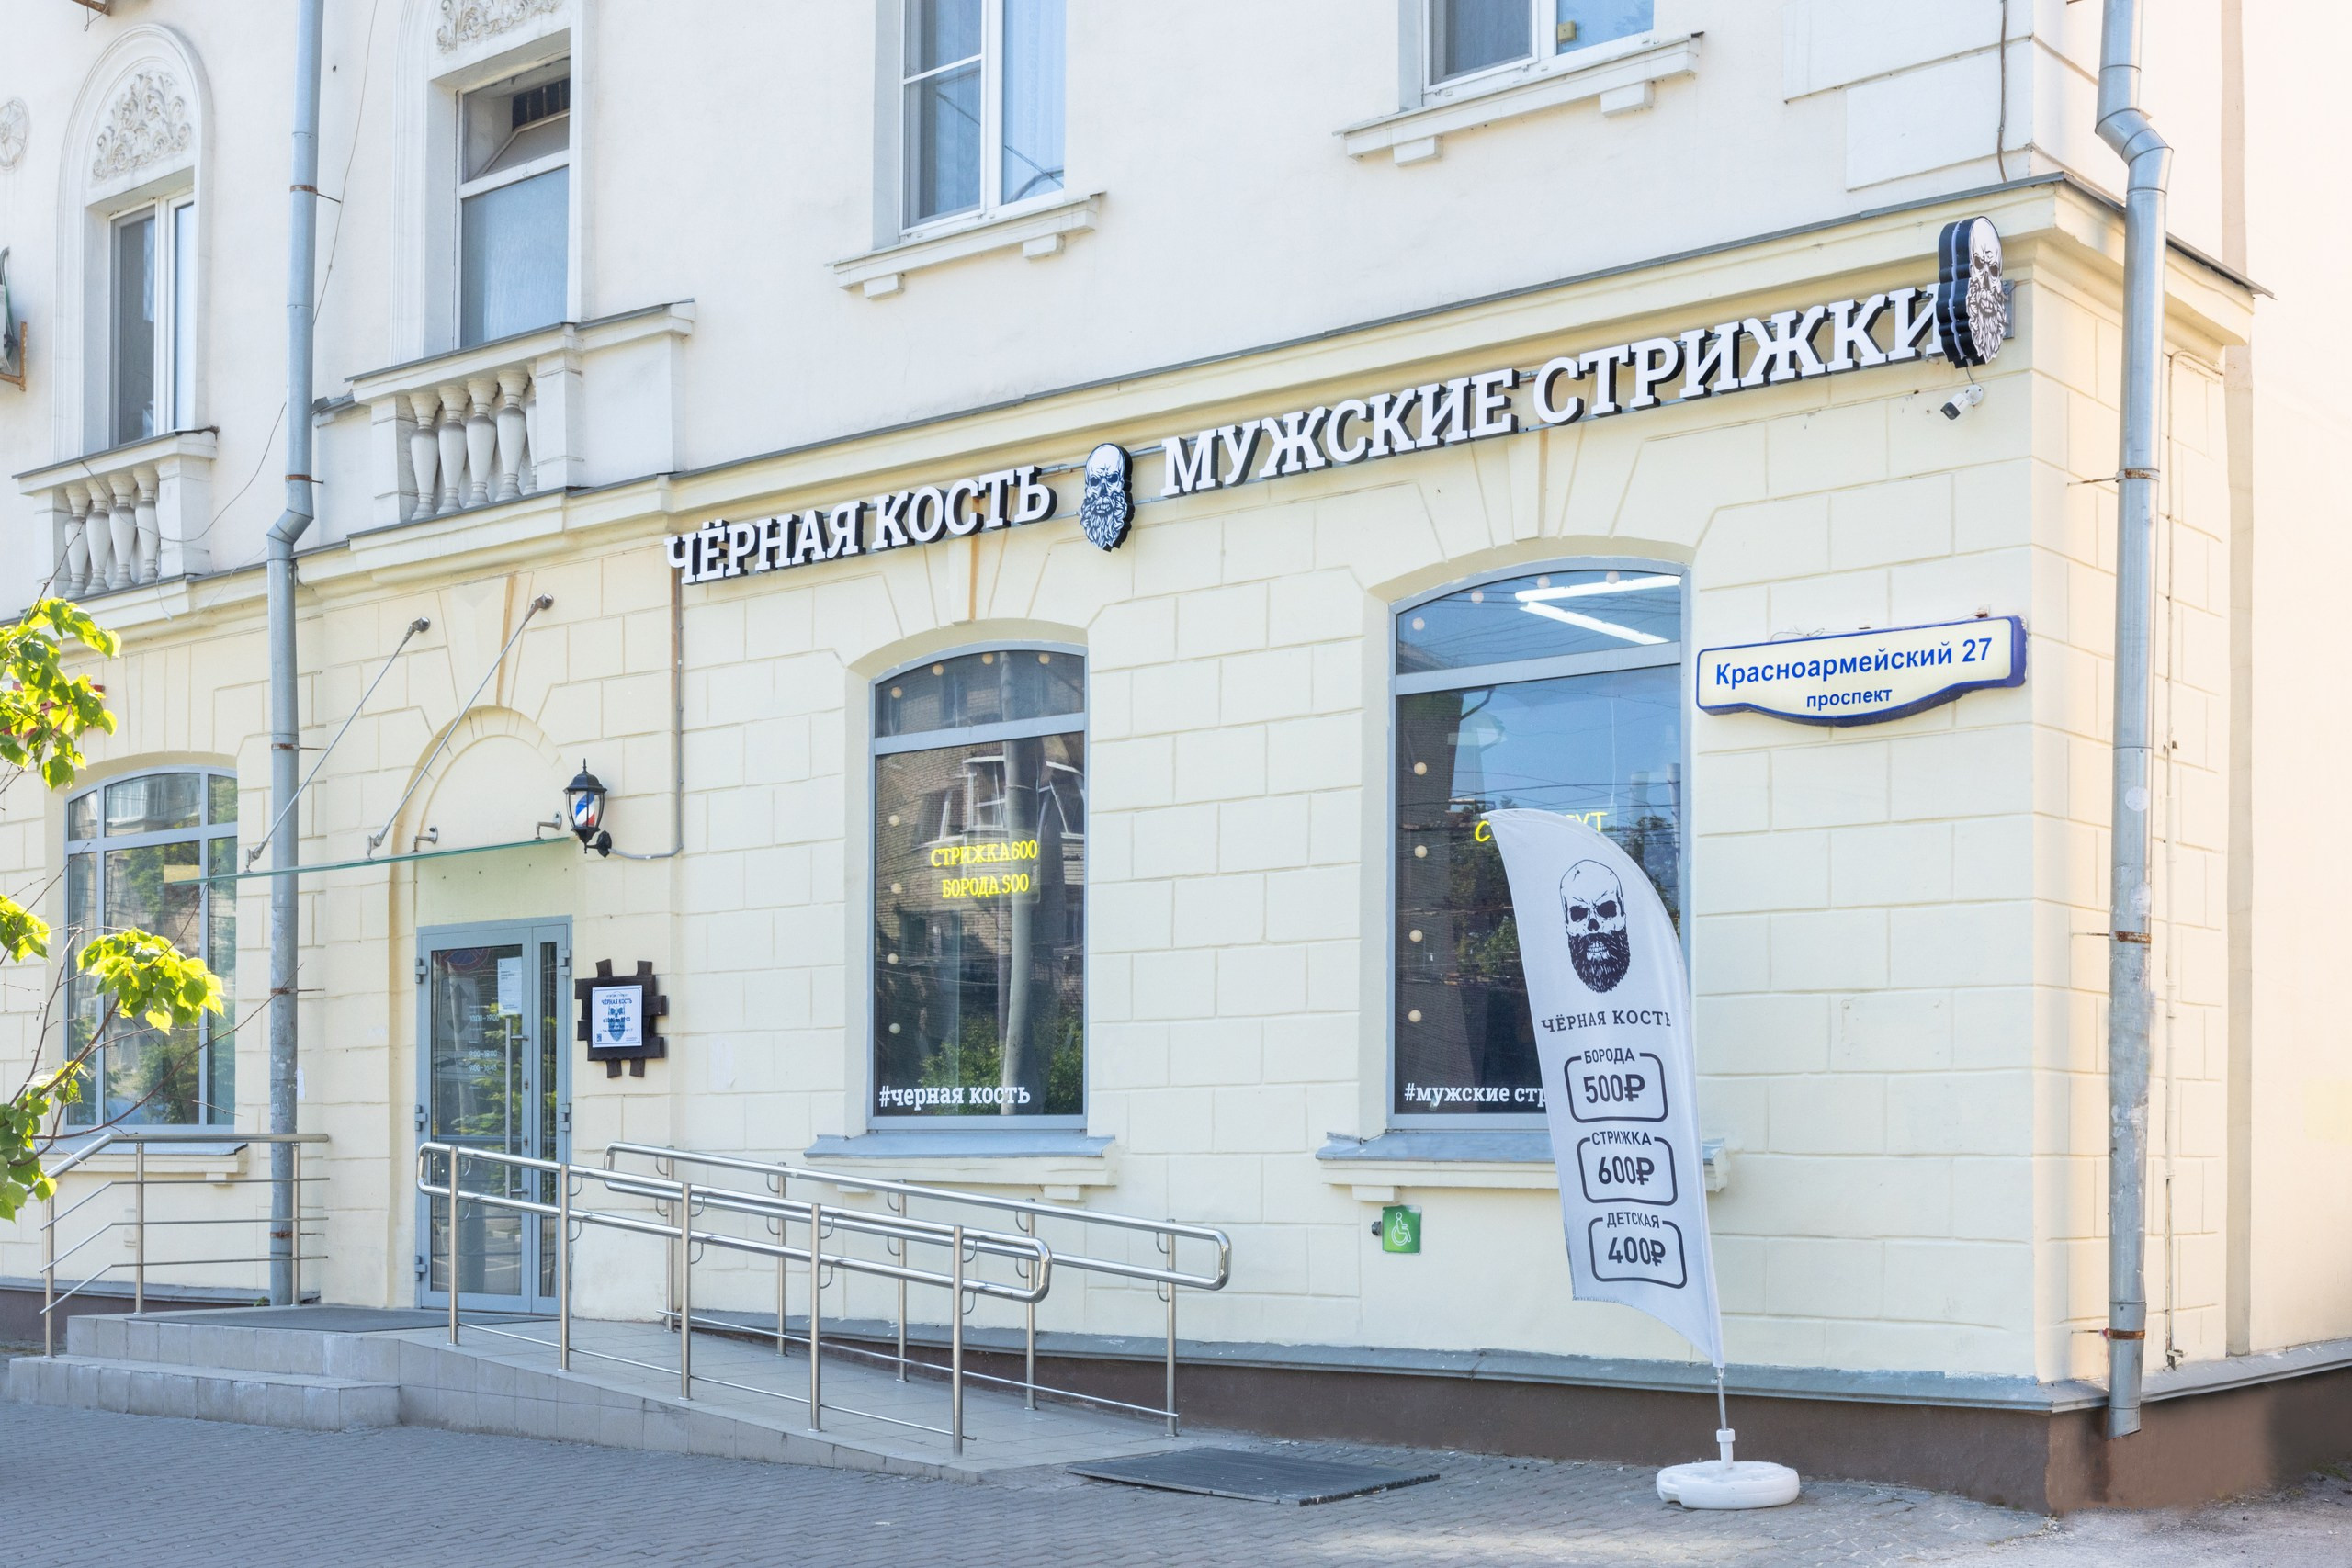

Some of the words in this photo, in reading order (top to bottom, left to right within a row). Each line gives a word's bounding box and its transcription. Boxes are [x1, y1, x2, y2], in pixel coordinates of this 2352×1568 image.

[1160, 368, 1518, 498] МУЖСКИЕ
[1532, 282, 1943, 425] СТРИЖКИ
[664, 500, 865, 585] ЧЁРНАЯ
[871, 465, 1057, 550] КОСТЬ
[1715, 641, 1952, 689] Красноармейский
[1962, 637, 1993, 663] 27
[1806, 687, 1893, 711] проспект
[942, 875, 1001, 898] БОРОДА
[1002, 873, 1030, 893] 500
[1540, 1010, 1607, 1033] ЧЁРНАЯ
[1583, 1047, 1635, 1065] БОРОДА
[879, 1085, 965, 1111] #черная
[968, 1086, 1031, 1105] кость
[1404, 1082, 1510, 1109] #мужские
[1514, 1086, 1547, 1109] стр
[1583, 1073, 1645, 1104] 500₽
[1591, 1130, 1653, 1146] СТРИЖКА
[1598, 1156, 1655, 1186] 600₽
[1606, 1212, 1660, 1229] ДЕТСКАЯ
